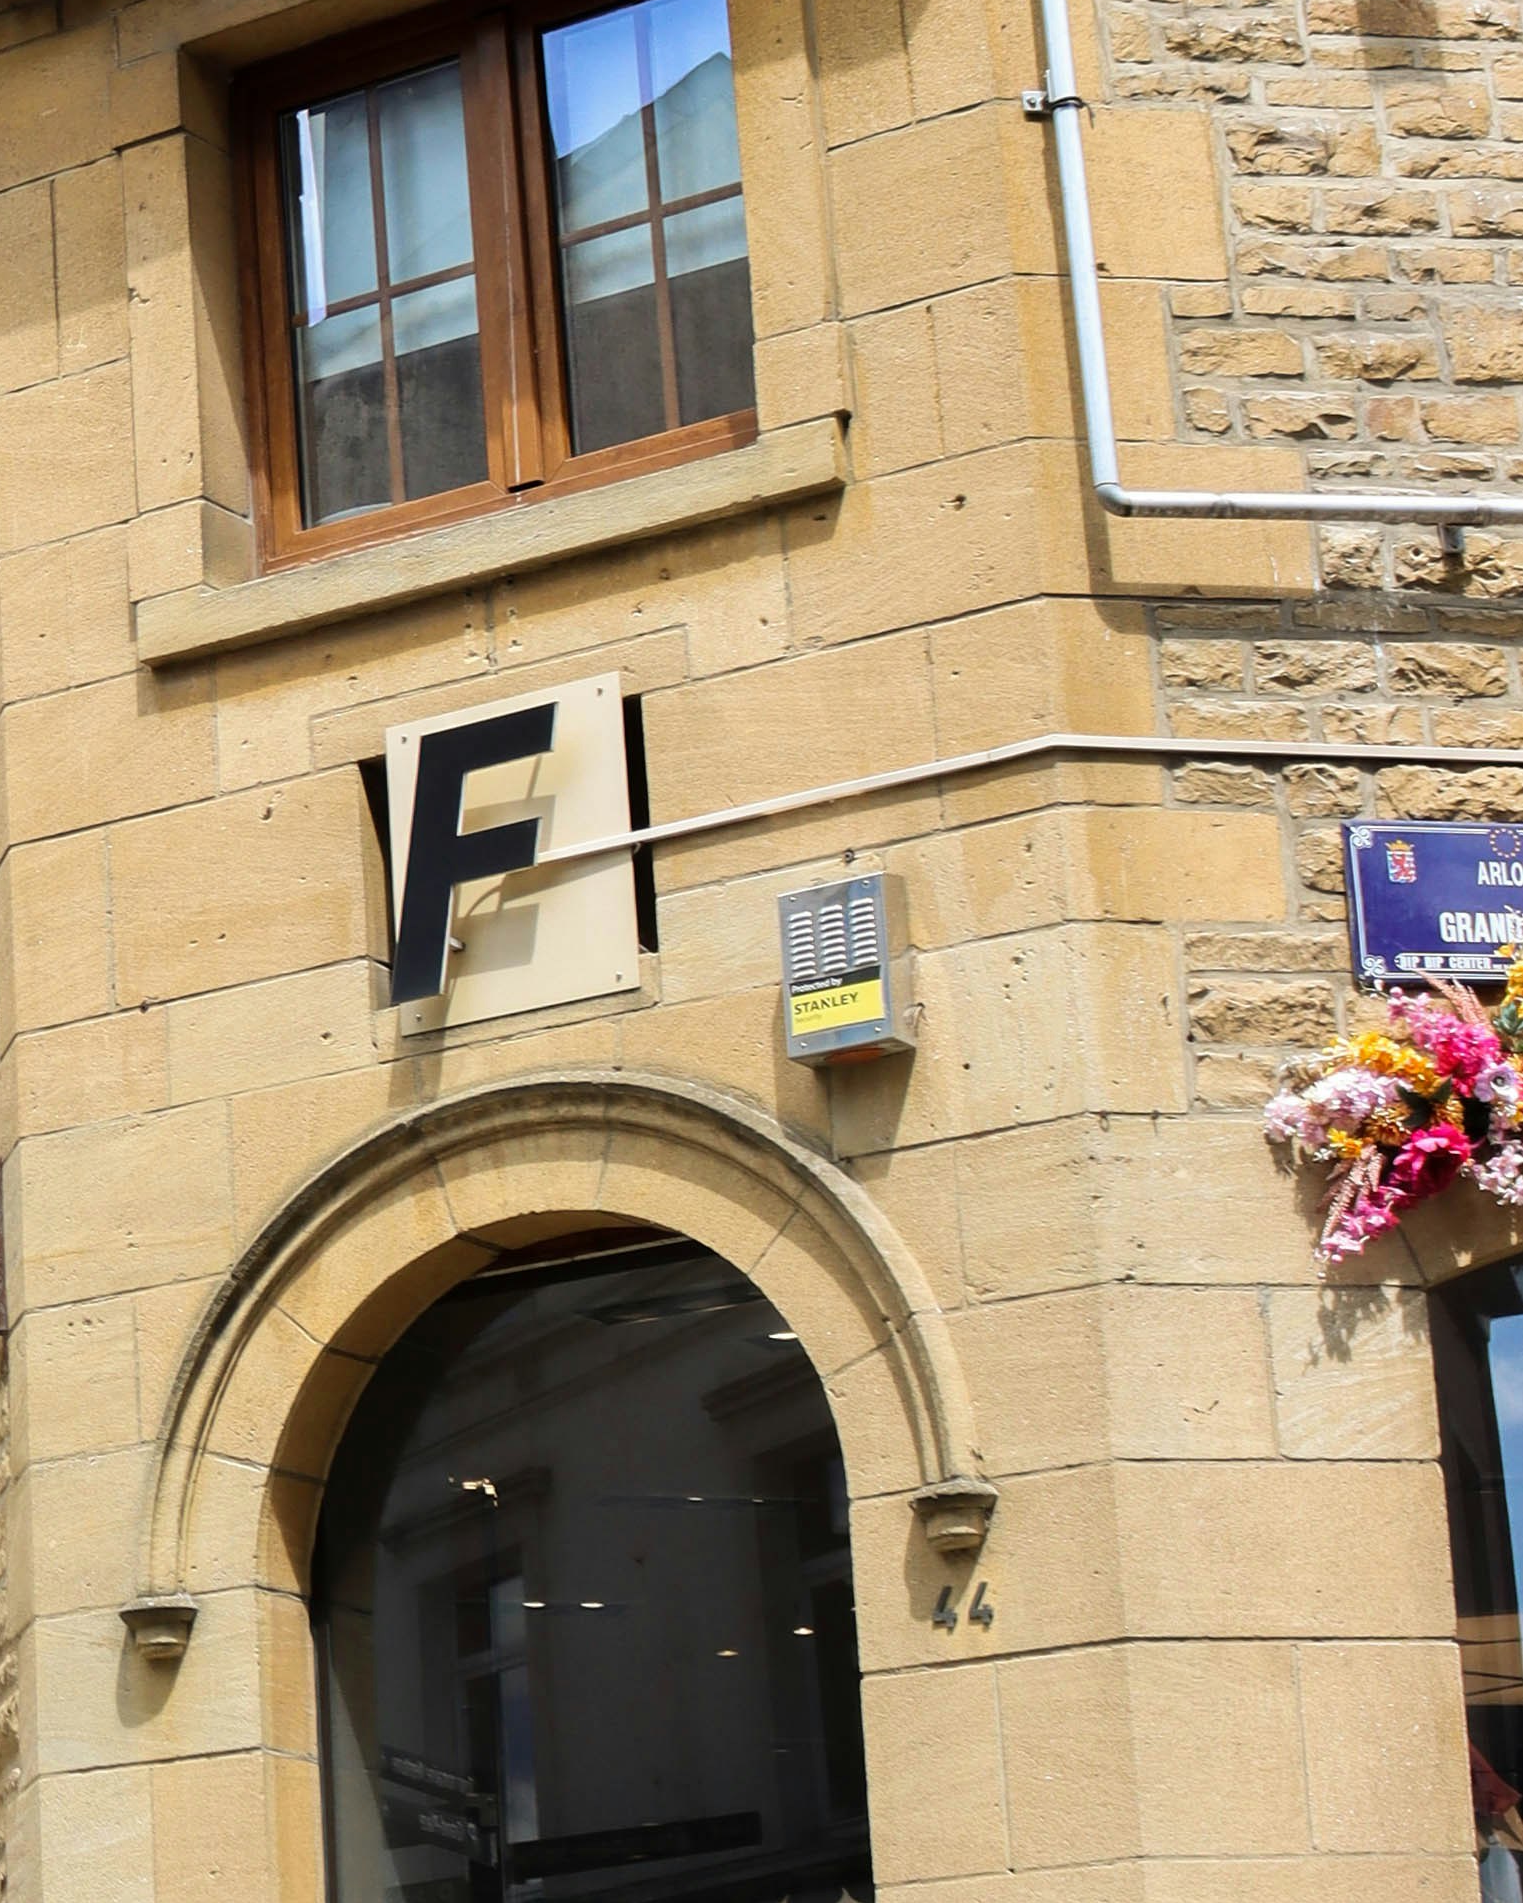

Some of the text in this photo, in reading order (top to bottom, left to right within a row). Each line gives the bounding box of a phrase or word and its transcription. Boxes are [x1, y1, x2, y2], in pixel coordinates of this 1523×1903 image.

[791, 978, 830, 994] Protected
[794, 991, 858, 1015] STANLEY
[932, 1582, 995, 1632] 44
